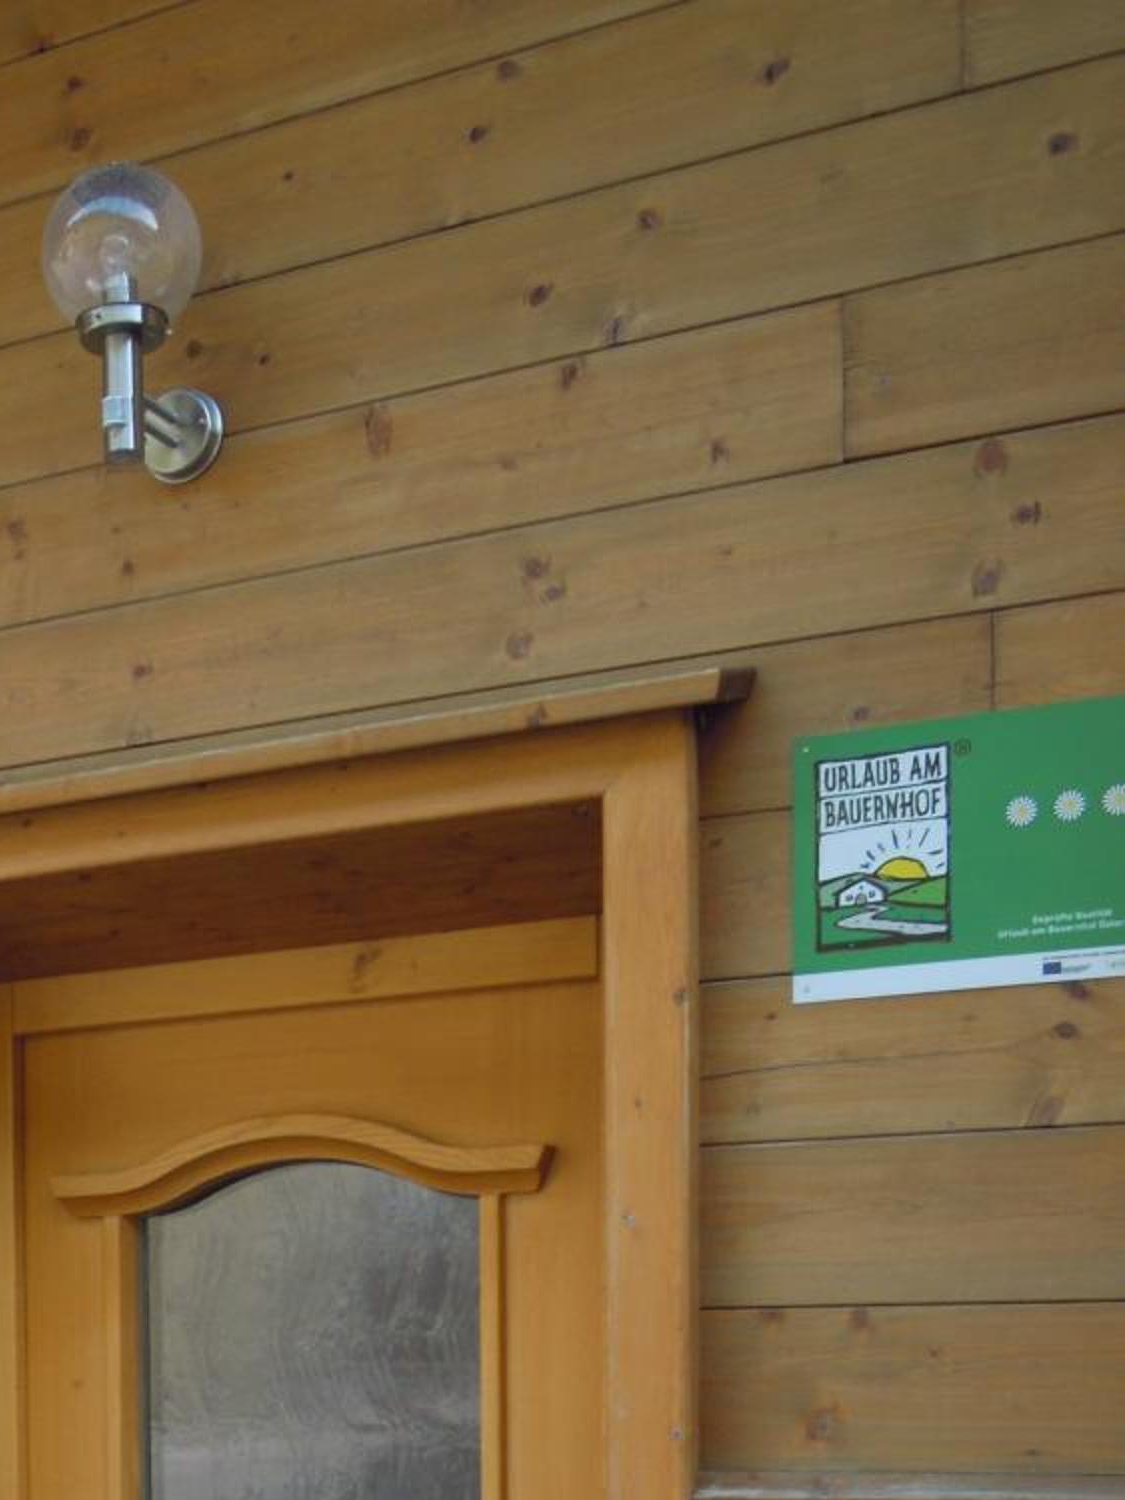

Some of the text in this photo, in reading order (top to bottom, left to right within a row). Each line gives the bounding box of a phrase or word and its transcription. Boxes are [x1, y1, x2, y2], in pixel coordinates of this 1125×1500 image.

[824, 751, 942, 792] URLAUB AM
[825, 787, 941, 827] BAUERNHOF
